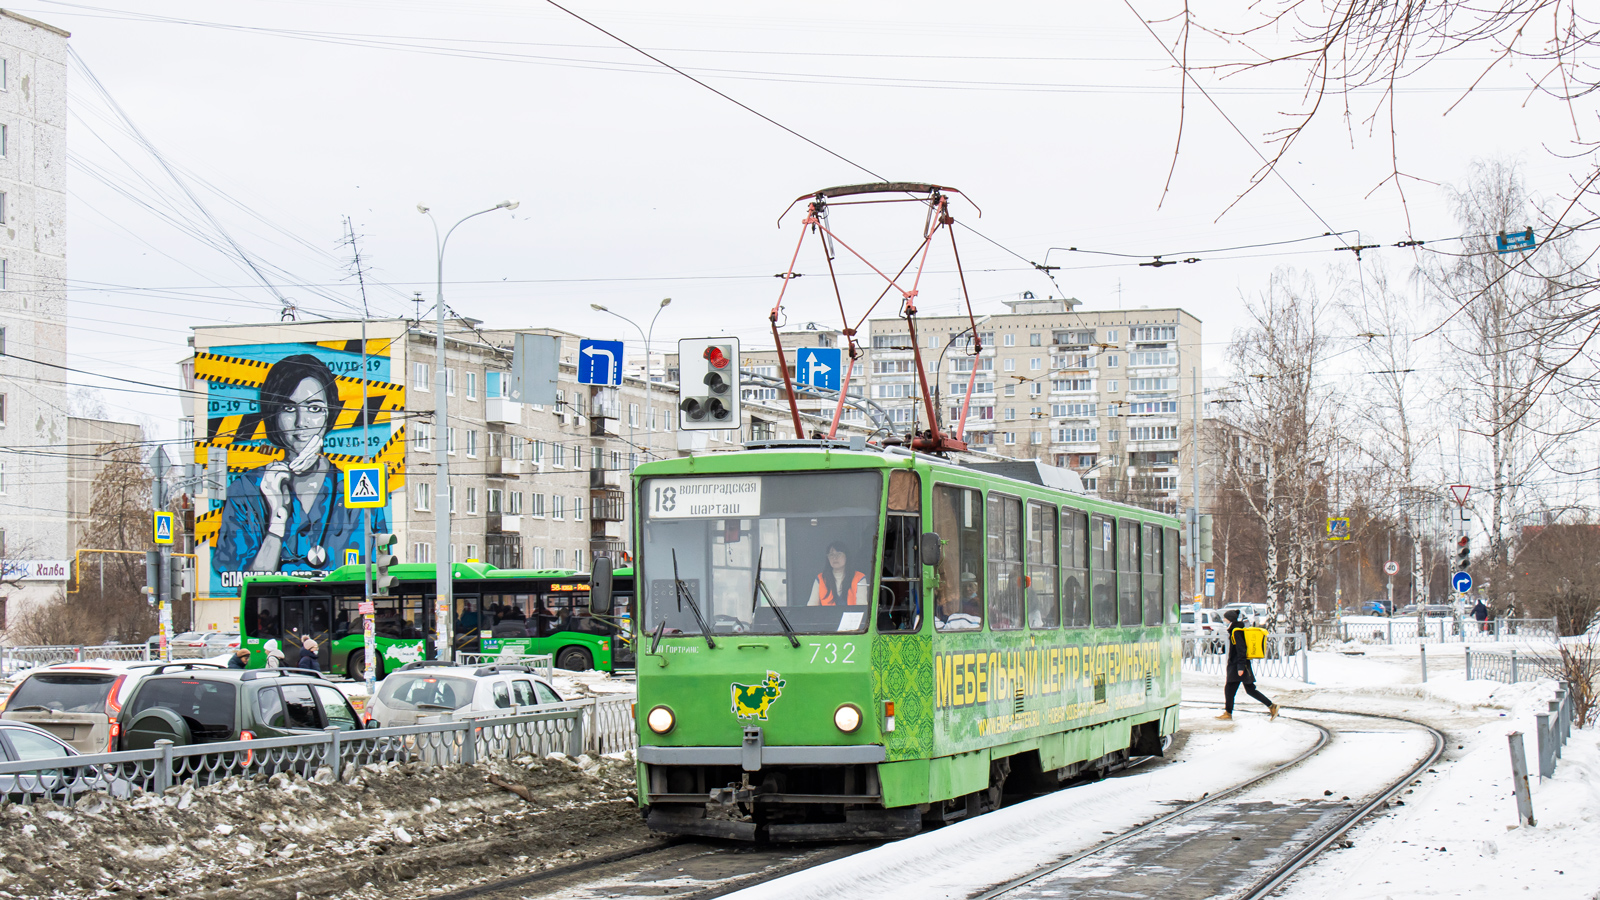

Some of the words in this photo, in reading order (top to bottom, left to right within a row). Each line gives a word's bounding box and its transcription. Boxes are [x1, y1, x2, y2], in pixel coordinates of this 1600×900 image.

[655, 486, 676, 512] 18
[36, 563, 65, 576] Халва
[809, 642, 856, 664] 732
[935, 635, 1039, 709] МЕБЕЛЬНЫЙ
[1041, 644, 1080, 696] ЦЕНТР
